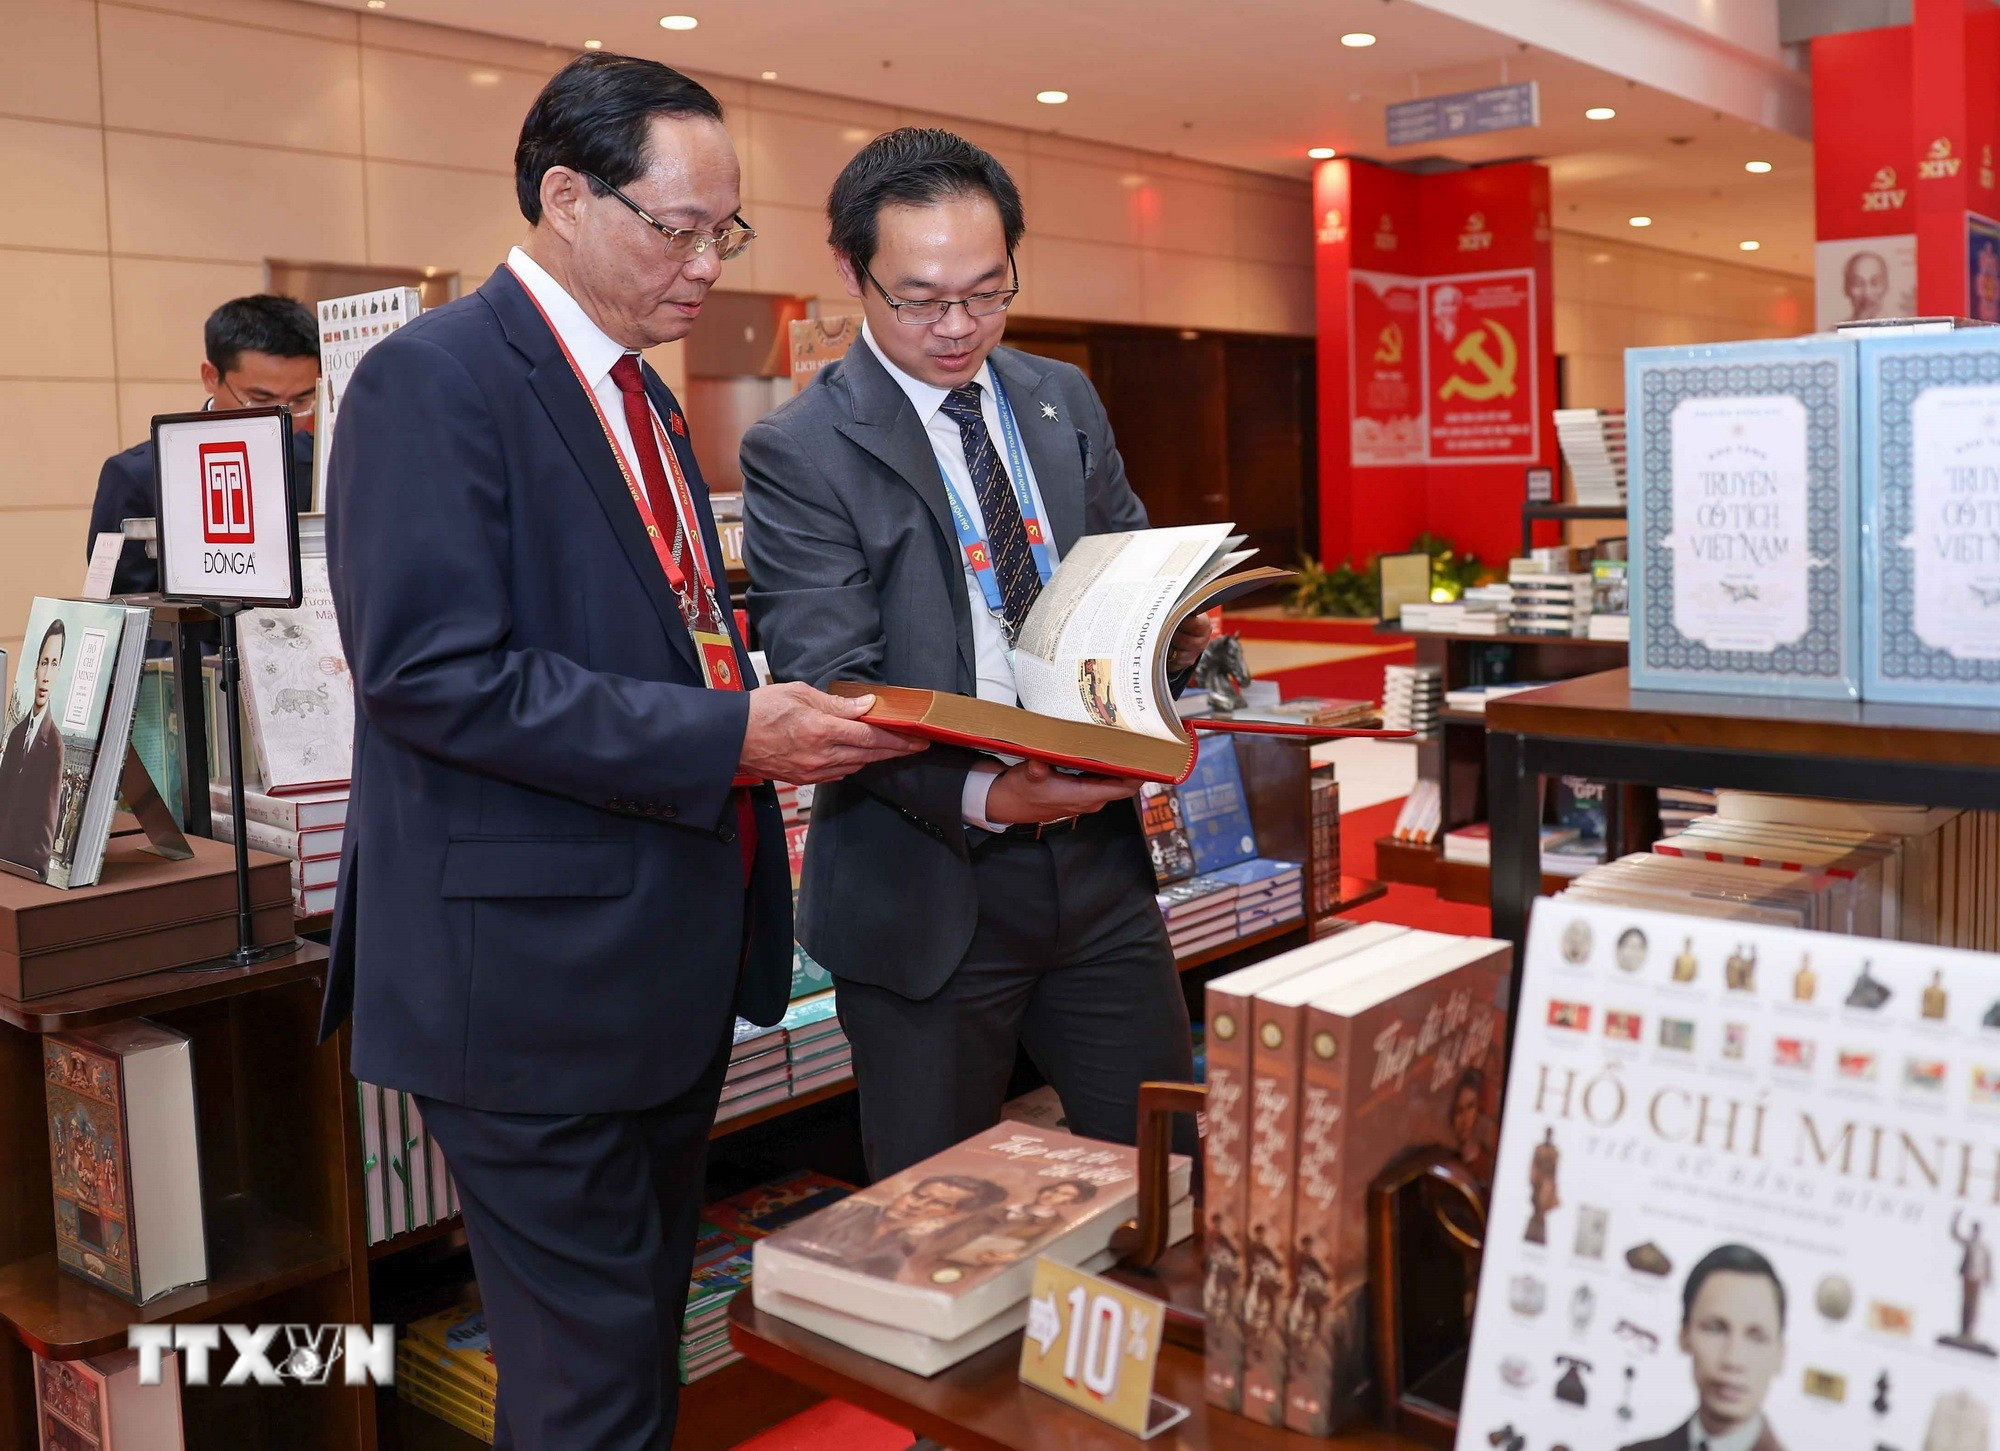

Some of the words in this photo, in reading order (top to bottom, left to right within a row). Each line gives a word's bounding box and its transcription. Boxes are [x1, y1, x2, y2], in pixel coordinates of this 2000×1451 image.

[1533, 1059, 1627, 1129] HỒ
[1648, 1082, 1773, 1158] CHÍ
[1792, 1110, 2000, 1206] MINH
